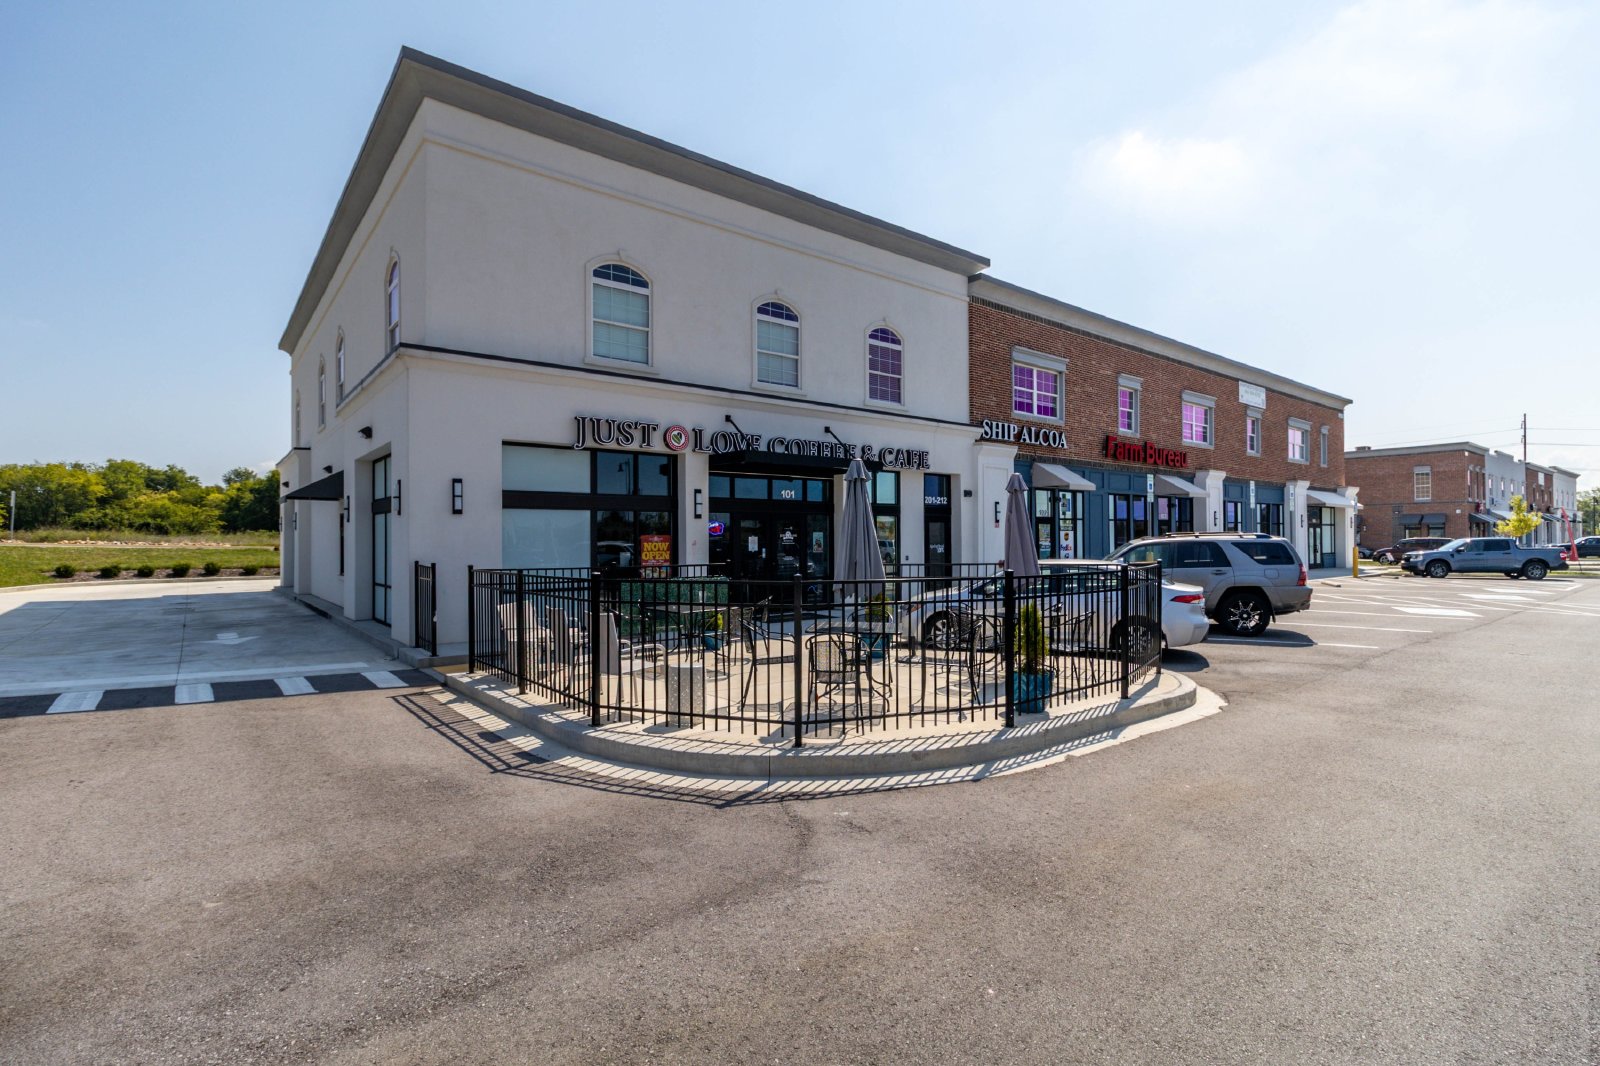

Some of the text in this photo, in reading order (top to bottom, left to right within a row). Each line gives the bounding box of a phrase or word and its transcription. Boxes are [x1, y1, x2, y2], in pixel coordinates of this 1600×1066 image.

[981, 419, 1068, 449] SHIP ALCOA
[573, 414, 659, 450] JUST
[691, 426, 763, 454] LOVE
[861, 444, 876, 461] &
[880, 447, 930, 470] CAFE
[1106, 435, 1187, 467] Farm Bureau
[781, 489, 795, 499] 101
[924, 496, 948, 505] 201-212
[643, 542, 669, 551] NOW
[641, 551, 670, 560] OPEN
